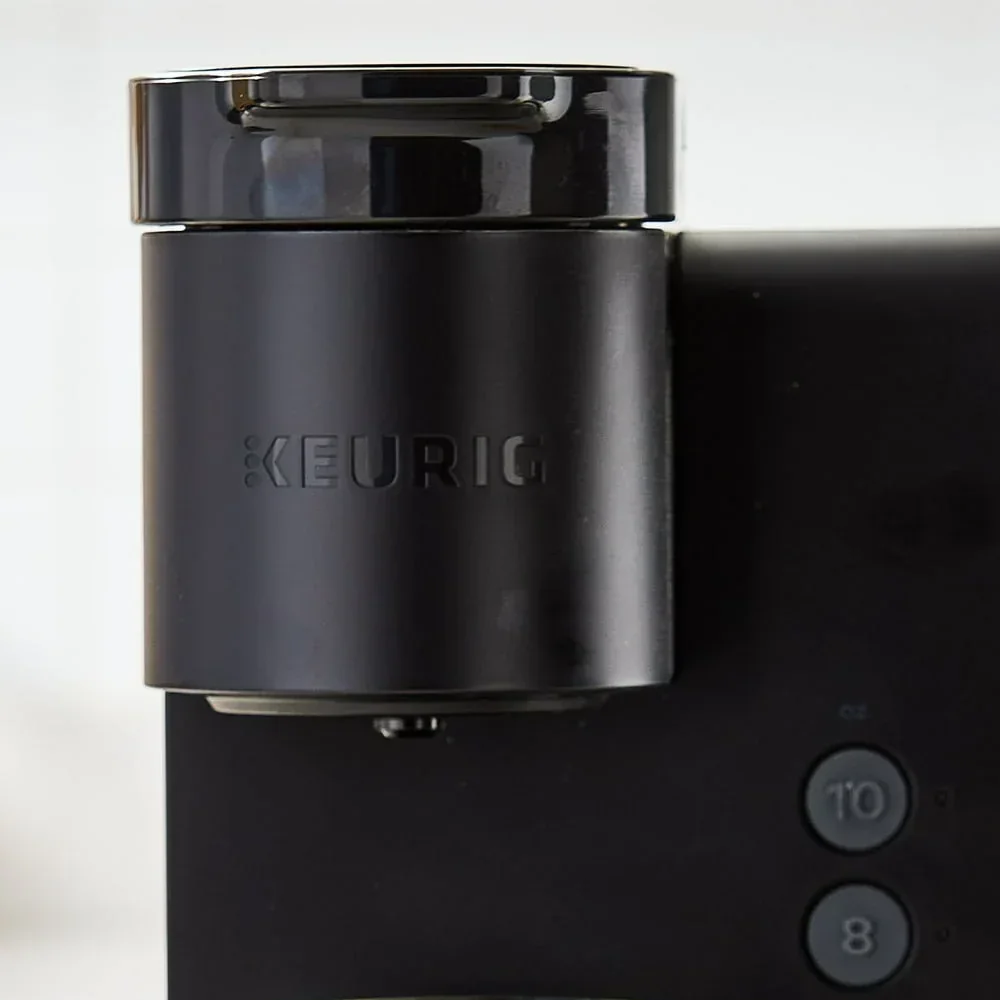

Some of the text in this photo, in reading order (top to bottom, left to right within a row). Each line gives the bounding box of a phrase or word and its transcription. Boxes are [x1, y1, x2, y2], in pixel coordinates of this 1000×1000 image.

[244, 434, 547, 489] KEURIG
[825, 780, 885, 821] 10
[842, 916, 873, 955] 8
